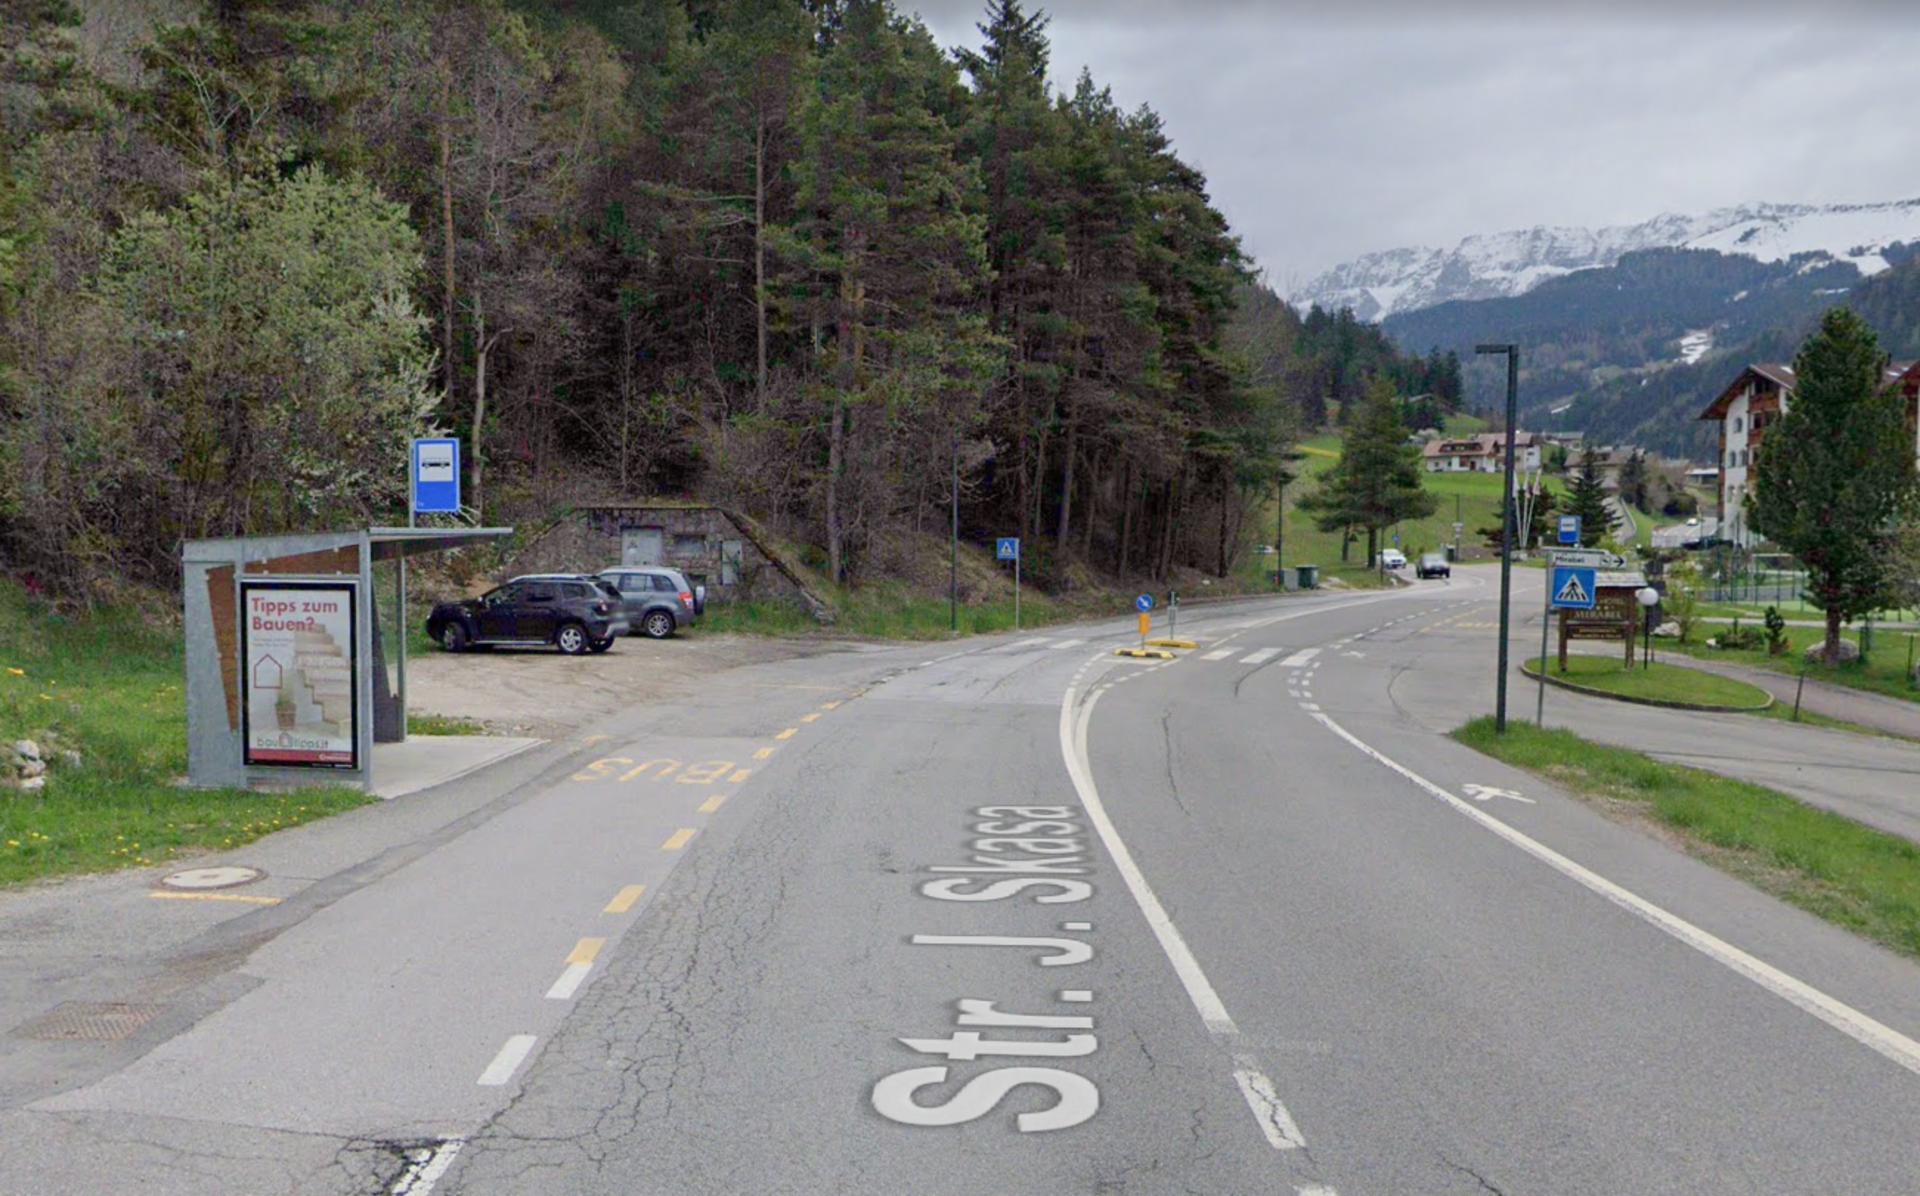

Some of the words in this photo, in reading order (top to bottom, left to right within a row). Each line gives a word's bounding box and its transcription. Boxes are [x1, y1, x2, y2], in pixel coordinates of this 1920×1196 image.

[252, 597, 297, 616] Tipps
[302, 602, 338, 613] zum
[252, 616, 315, 631] Bauen?
[571, 757, 737, 785] BUS
